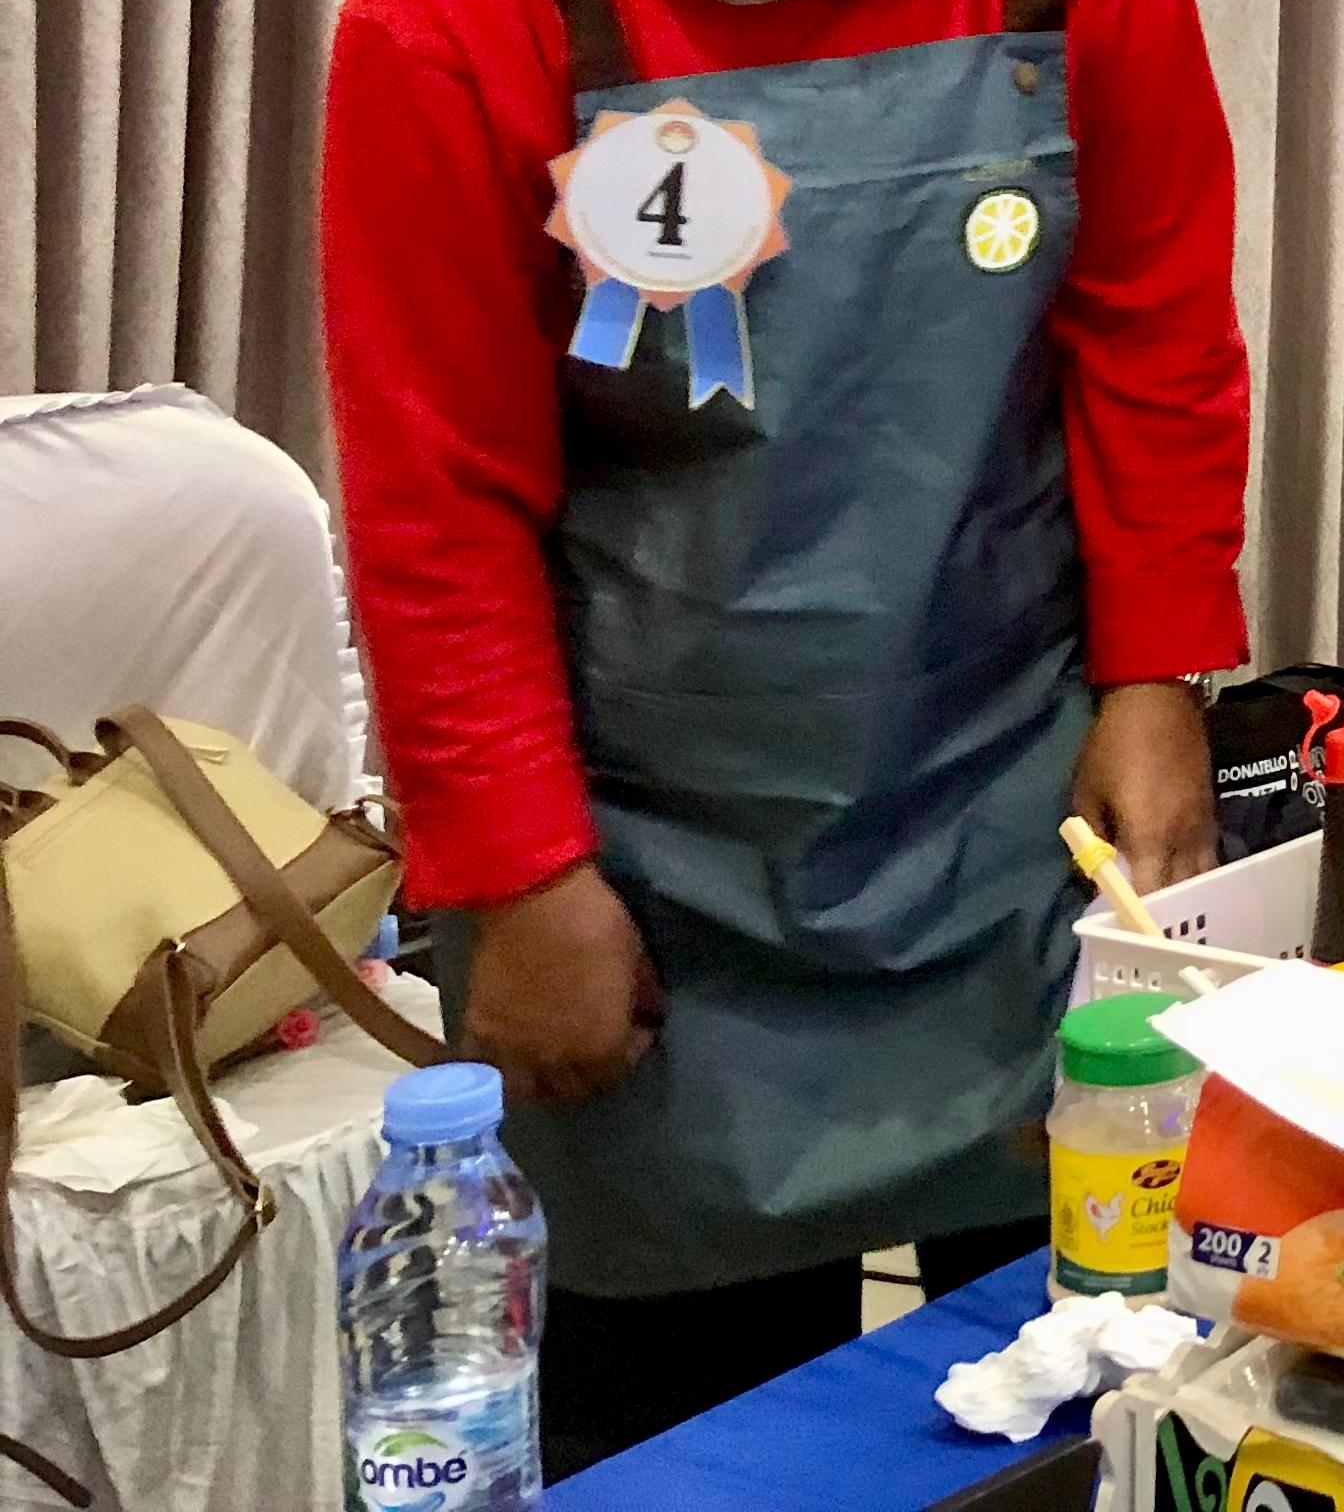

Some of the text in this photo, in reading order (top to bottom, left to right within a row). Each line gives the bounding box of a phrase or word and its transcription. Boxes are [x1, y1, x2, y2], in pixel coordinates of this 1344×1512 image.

[636, 161, 690, 246] 4
[1217, 754, 1288, 784] DONATELLO
[1197, 1227, 1242, 1258] 200
[1257, 1240, 1272, 1265] 2
